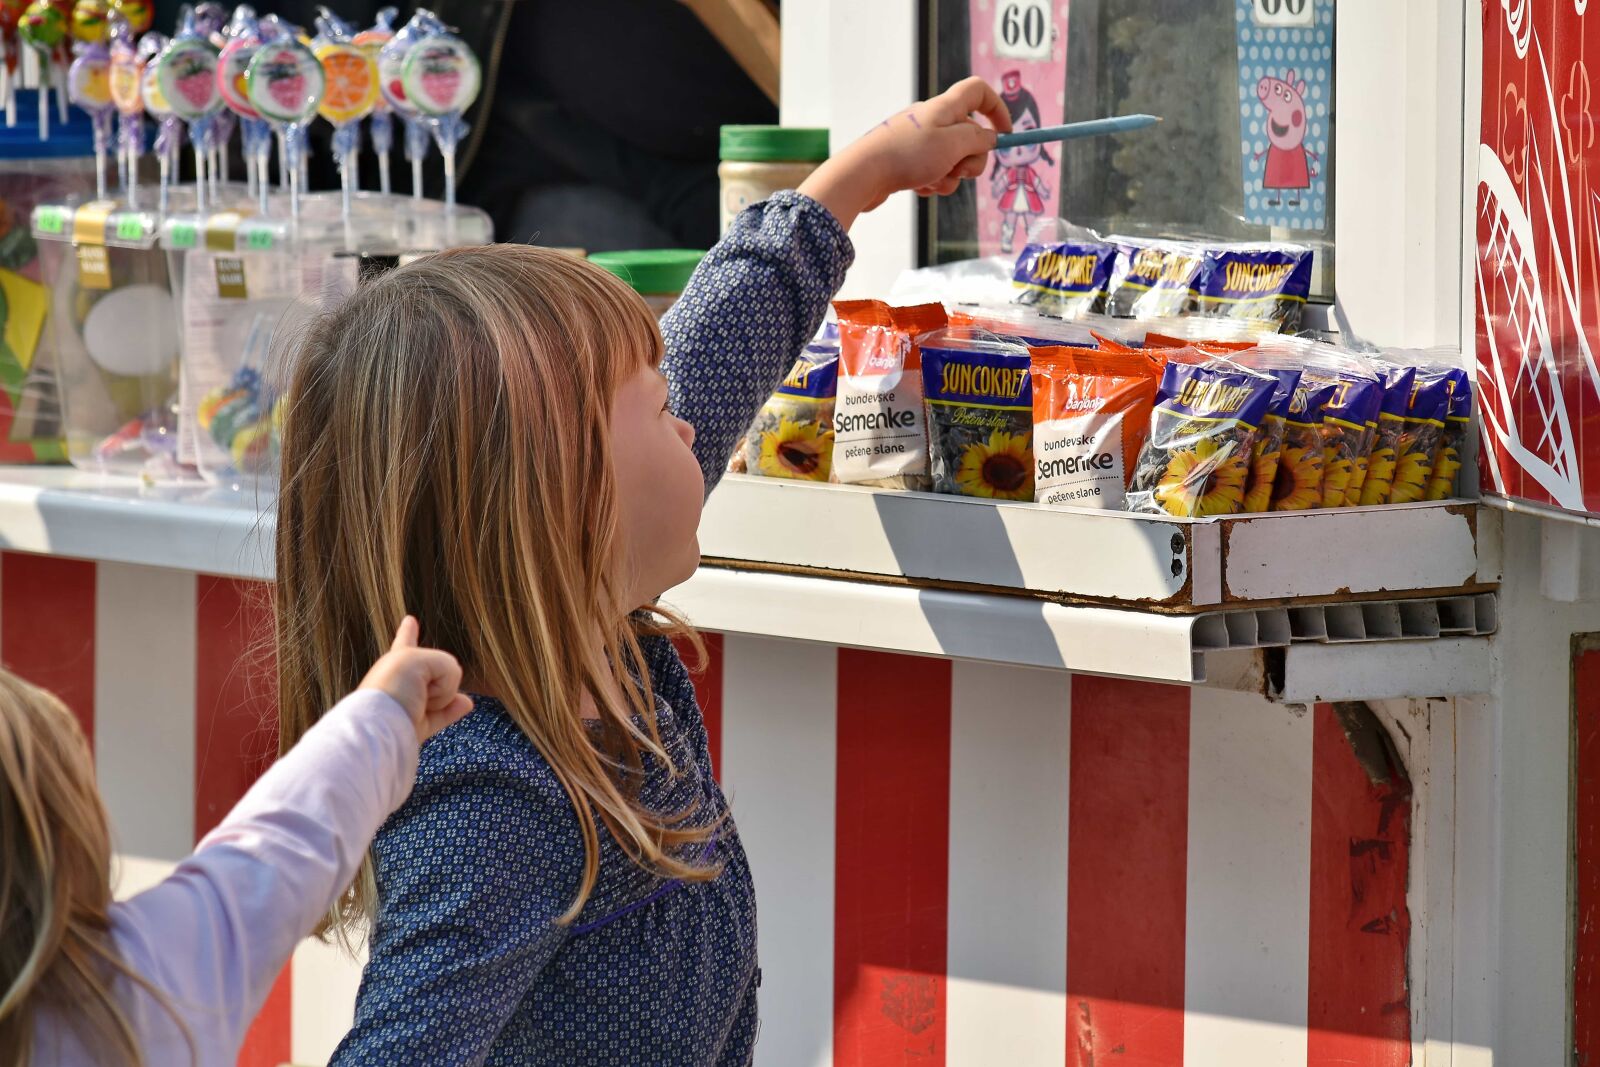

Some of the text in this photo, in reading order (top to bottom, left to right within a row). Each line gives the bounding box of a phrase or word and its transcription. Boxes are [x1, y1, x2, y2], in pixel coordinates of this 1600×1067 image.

[1002, 3, 1045, 48] 60
[941, 362, 1028, 399] SUNCOKRET
[845, 391, 896, 406] bundevske
[835, 407, 916, 434] Semenke
[845, 444, 905, 460] pečene slane
[1044, 435, 1096, 452] bundevske
[1047, 486, 1101, 505] pečene slane
